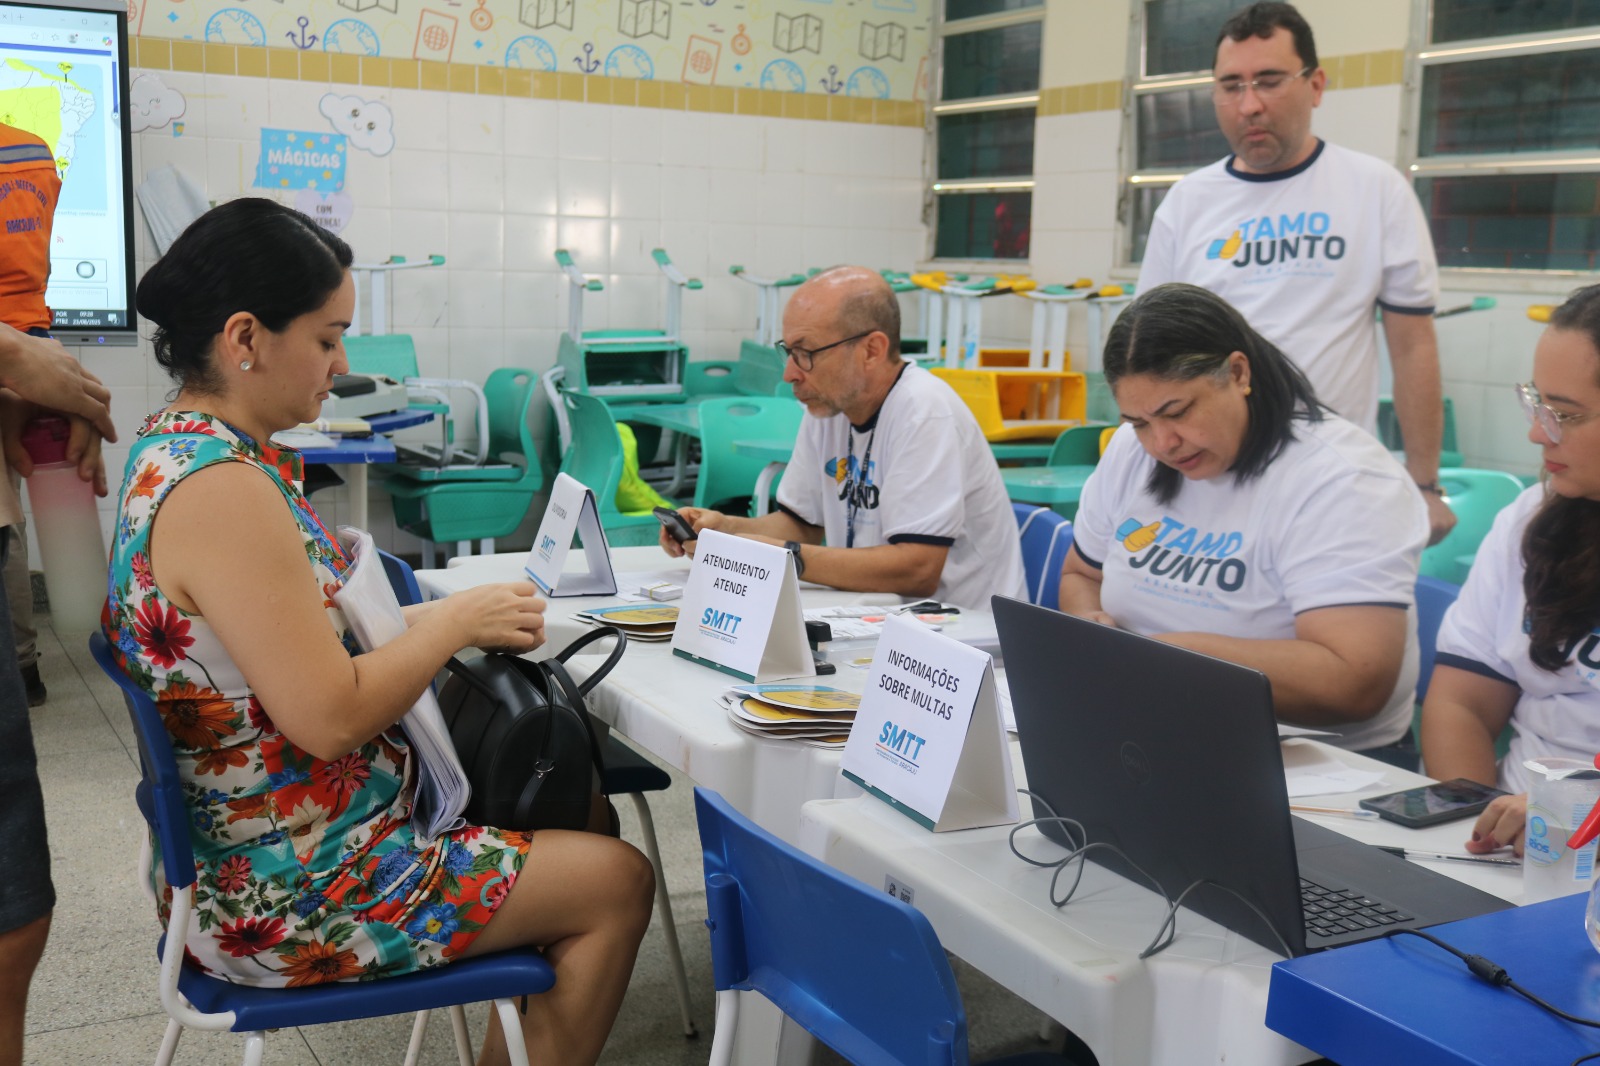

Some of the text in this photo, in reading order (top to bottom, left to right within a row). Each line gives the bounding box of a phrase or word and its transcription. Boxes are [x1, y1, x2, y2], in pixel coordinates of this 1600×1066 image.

[268, 146, 341, 169] MÁGICAS
[316, 205, 332, 214] COM
[1239, 211, 1330, 241] TAMO
[1232, 235, 1346, 267] JUNTO
[541, 534, 556, 555] SMTT
[1154, 516, 1243, 558] TAMO
[703, 553, 770, 581] ATENDIMENTO/
[1128, 545, 1246, 592] JUNTO
[713, 578, 748, 597] ATENDE
[701, 607, 742, 634] SMTT
[887, 649, 960, 693] INFORMAÇÕES
[879, 674, 954, 721] SOBRE MULTAS
[879, 721, 926, 761] SMTT
